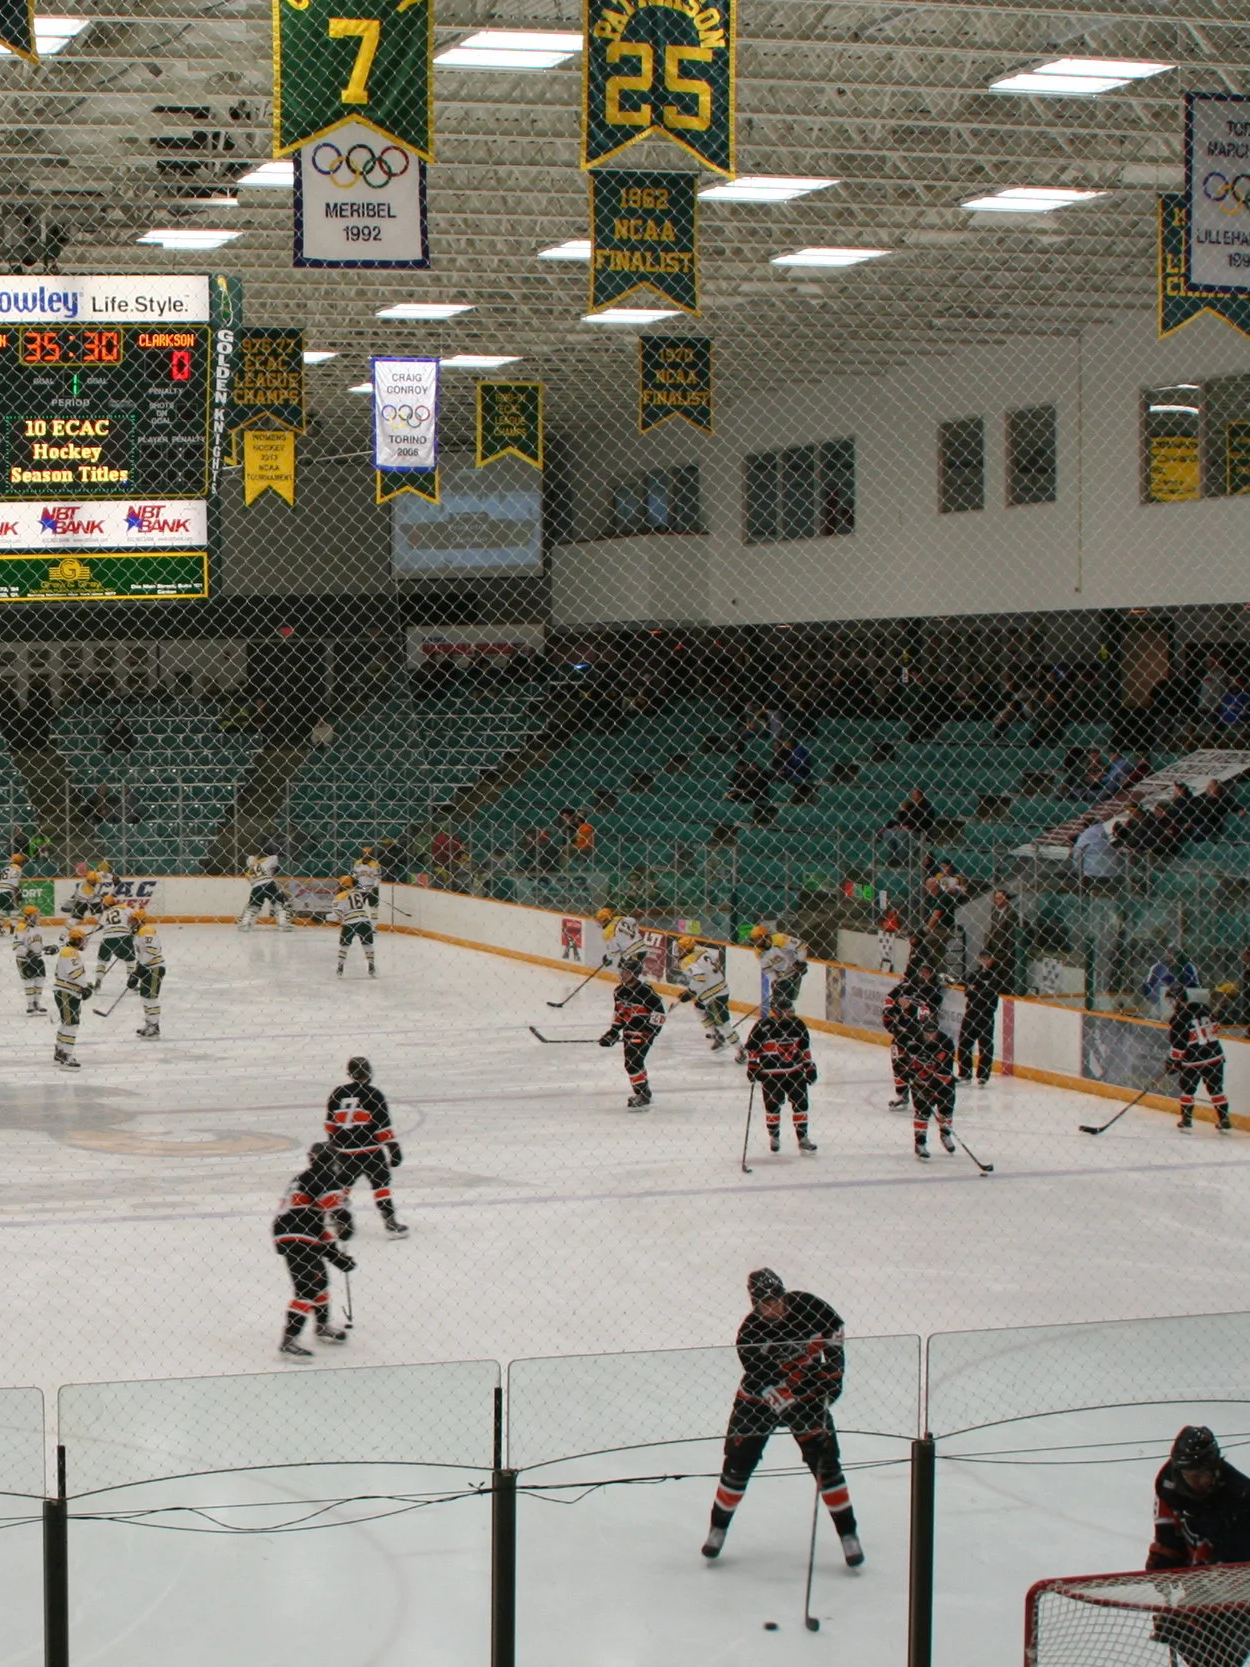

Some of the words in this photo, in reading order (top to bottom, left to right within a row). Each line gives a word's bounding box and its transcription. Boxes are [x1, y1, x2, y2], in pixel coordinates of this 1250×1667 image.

[328, 18, 381, 104] 7
[605, 41, 713, 131] 25
[324, 202, 397, 220] MERIBEL
[342, 226, 383, 243] 1992
[613, 218, 676, 242] NCAA
[596, 251, 694, 273] FINALIST
[24, 331, 119, 362] 35:30
[138, 333, 195, 348] CLARKSON
[171, 350, 192, 381] 0
[391, 373, 423, 383] CRAIG
[233, 389, 300, 405] CHAMPS
[386, 385, 428, 395] CONROY
[642, 390, 710, 406] FINALIST
[51, 398, 91, 408] PERIOD
[24, 419, 47, 437] 10
[52, 419, 110, 437] ECAC
[389, 434, 428, 445] TORINO
[32, 443, 103, 463] Hockey
[10, 466, 74, 483] Season
[78, 465, 130, 483] Titles
[40, 506, 81, 521] NBT
[126, 504, 167, 520] NBT
[51, 520, 106, 535] BANK
[137, 519, 192, 533] BANK
